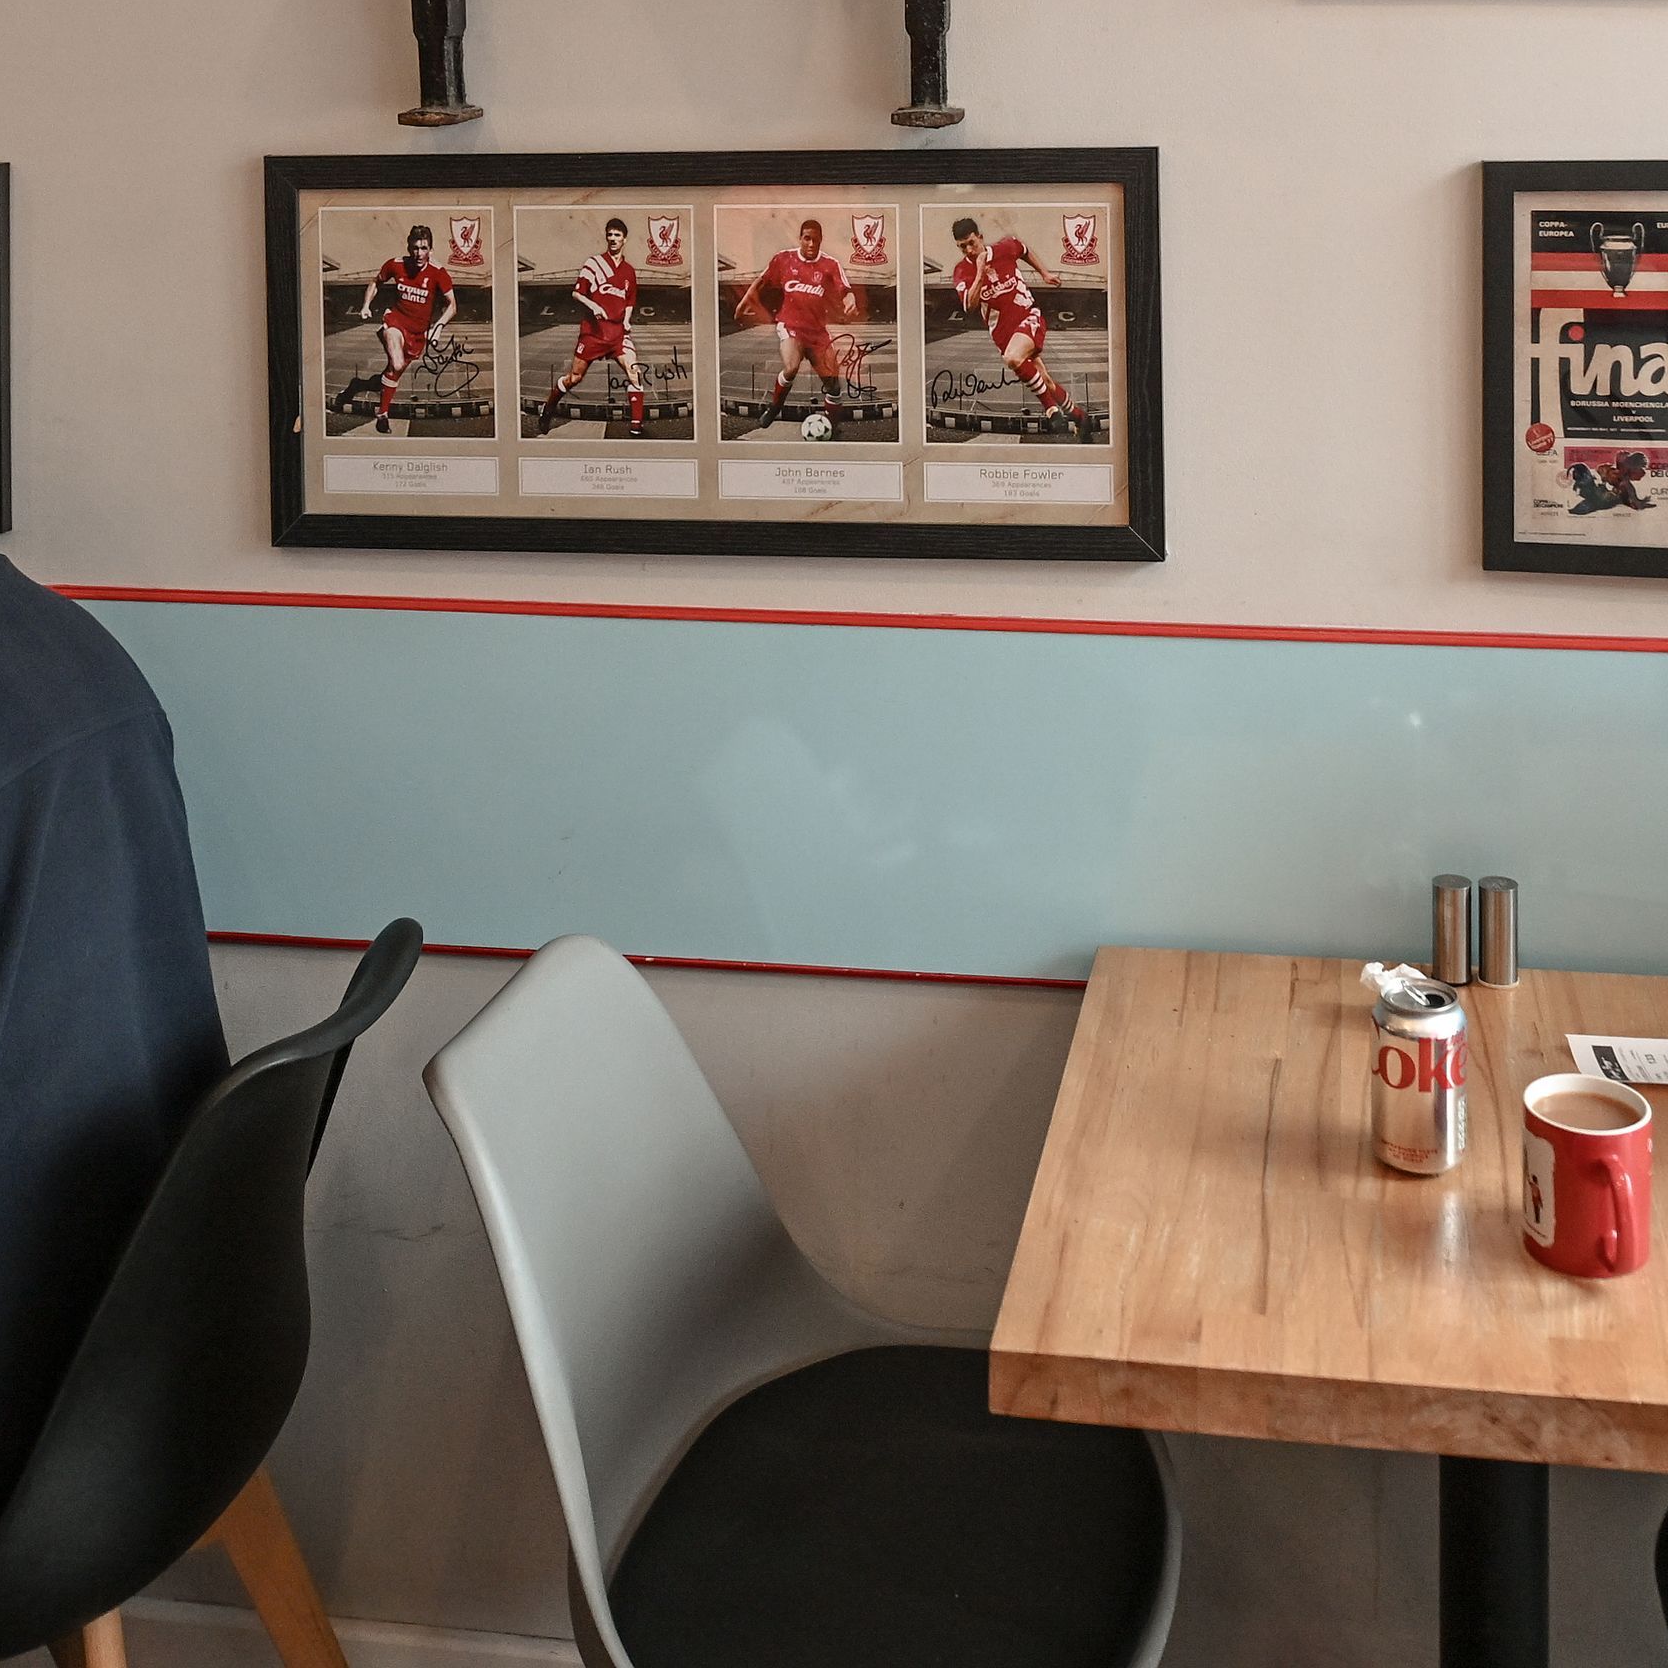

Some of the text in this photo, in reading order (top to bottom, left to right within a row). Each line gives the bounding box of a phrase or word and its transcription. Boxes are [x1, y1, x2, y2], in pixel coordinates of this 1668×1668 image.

[1570, 400, 1610, 408] BORUSSIA
[1613, 415, 1654, 423] LIVERPOOL
[373, 461, 448, 474] Kenny Dalglish
[583, 464, 632, 475] Ian Rush
[775, 467, 845, 478] John Barnes
[979, 468, 1064, 480] Robbie Fowler
[1650, 470, 1664, 478] DEI
[1372, 1035, 1469, 1093] oke
